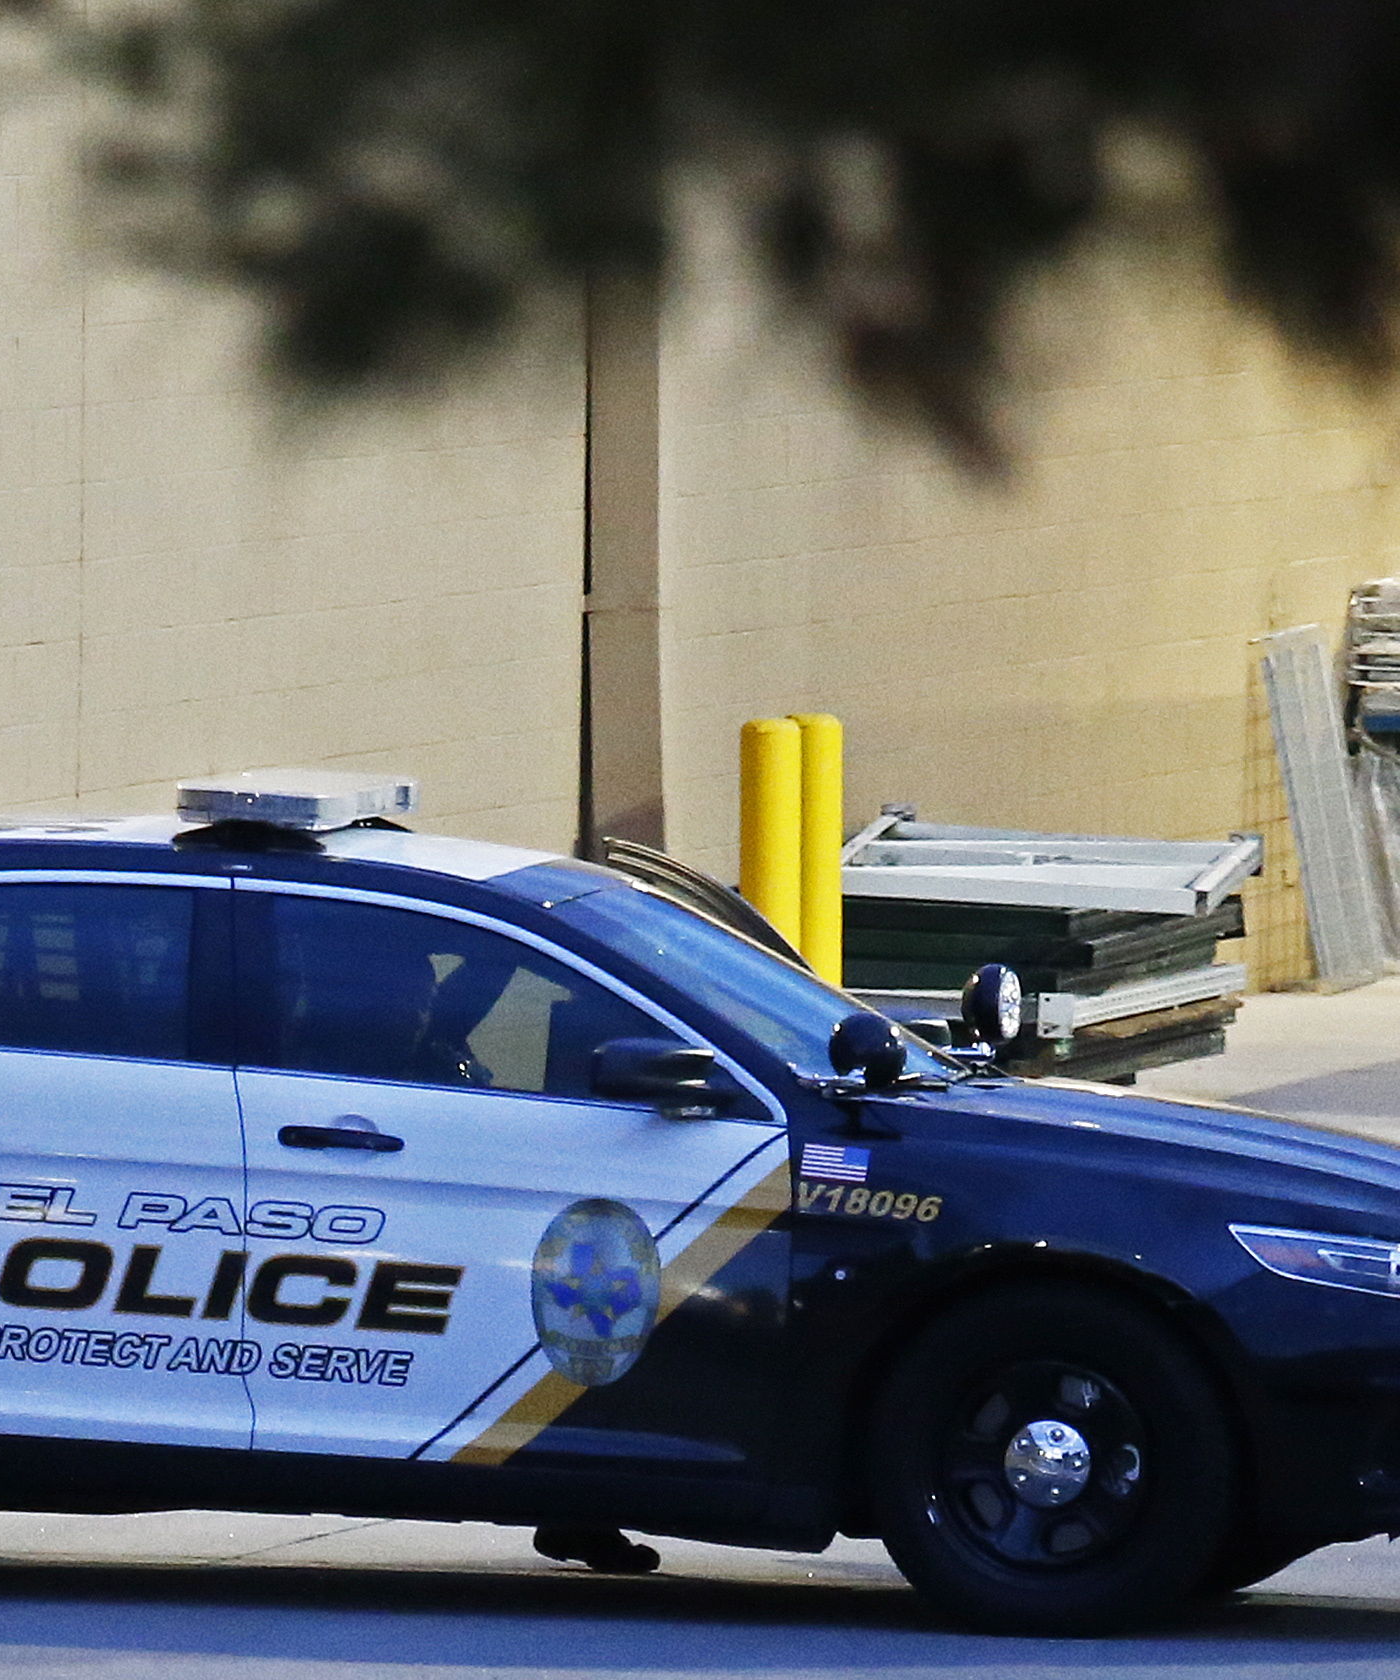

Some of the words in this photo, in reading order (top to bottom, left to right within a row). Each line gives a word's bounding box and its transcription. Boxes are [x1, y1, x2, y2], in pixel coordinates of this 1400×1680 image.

[116, 1190, 387, 1245] PASO
[798, 1181, 944, 1223] V18096
[166, 1337, 264, 1376] AND
[268, 1342, 415, 1387] SERVE
